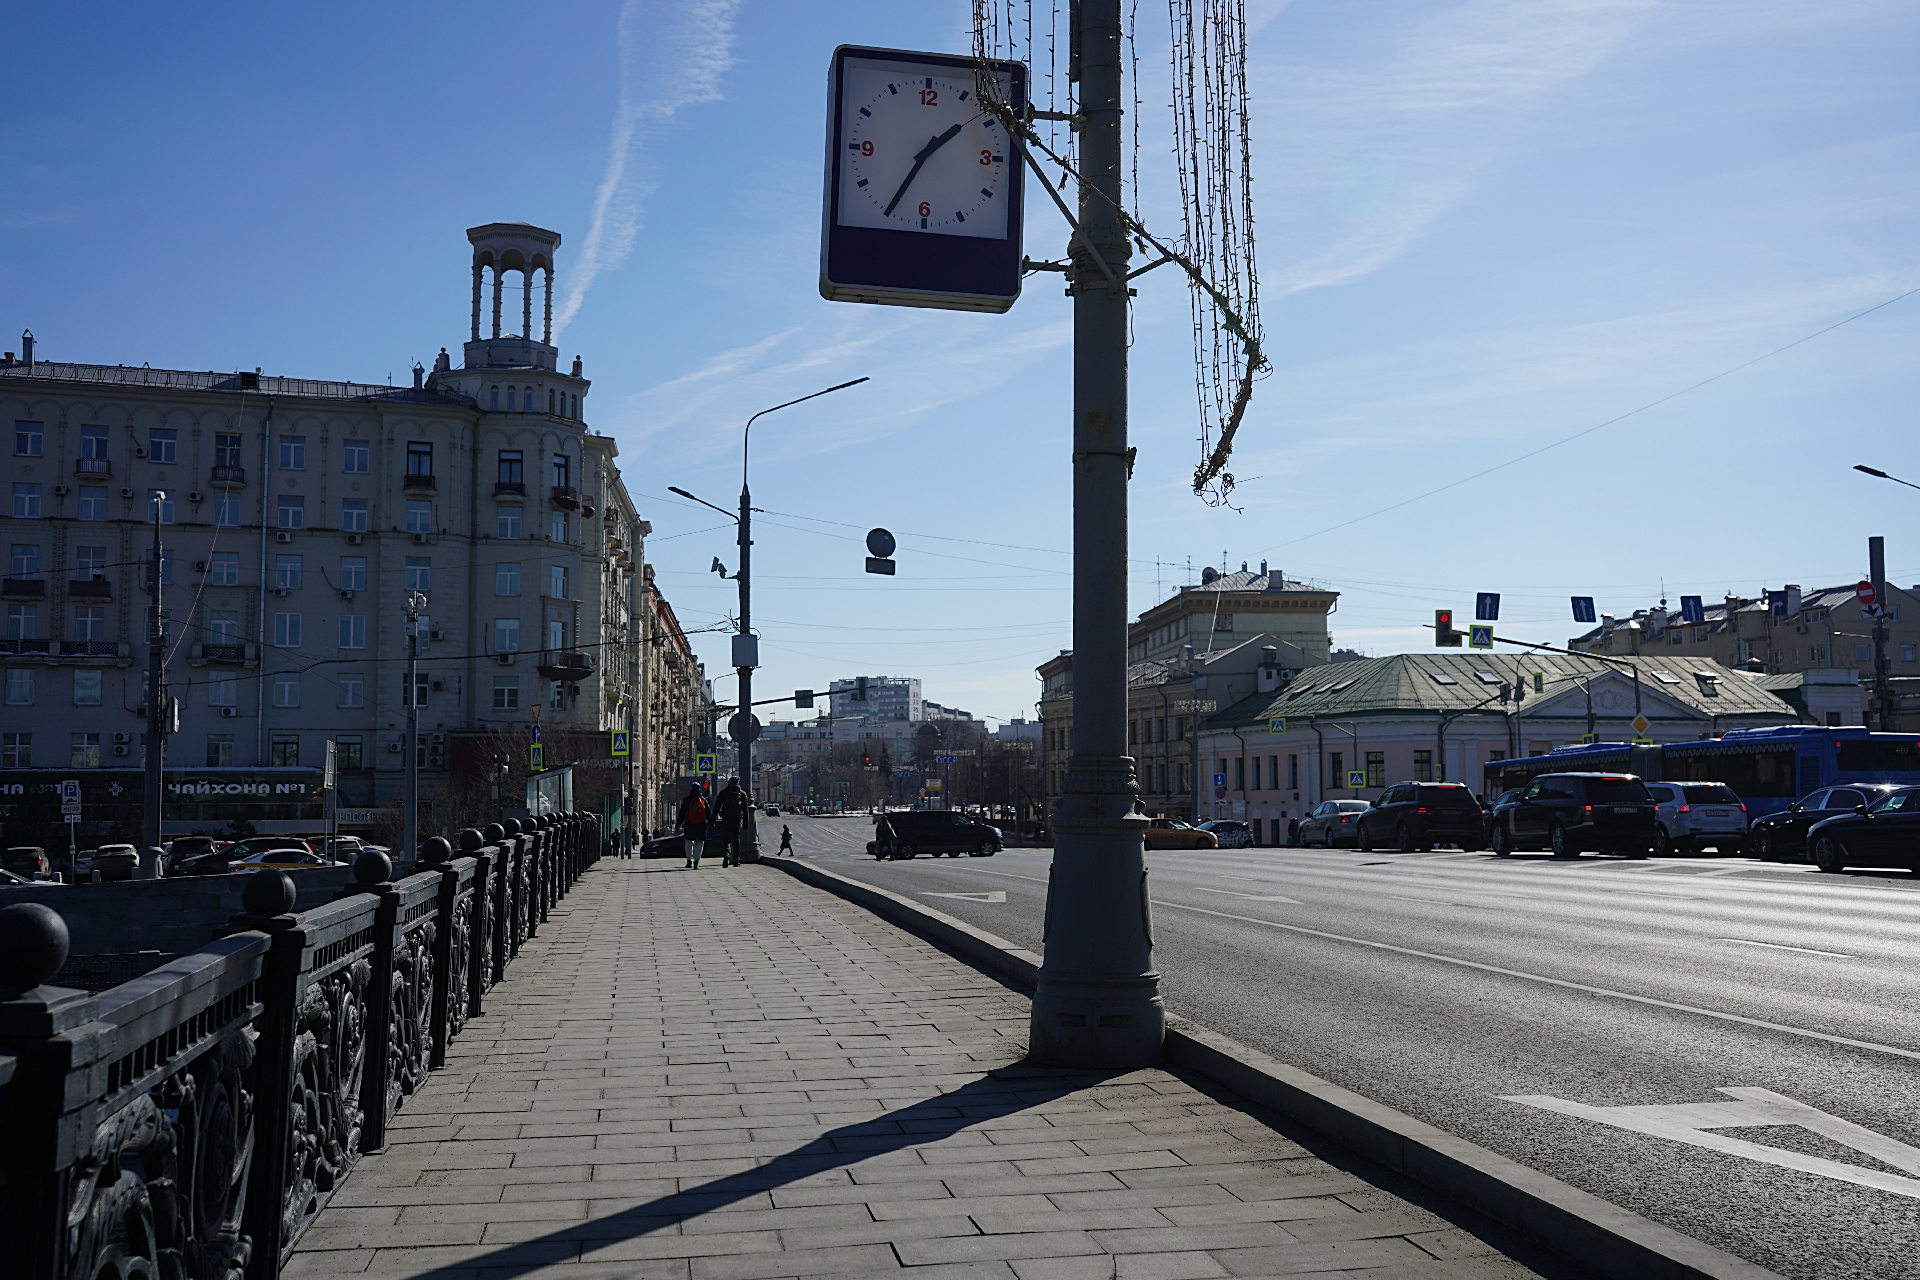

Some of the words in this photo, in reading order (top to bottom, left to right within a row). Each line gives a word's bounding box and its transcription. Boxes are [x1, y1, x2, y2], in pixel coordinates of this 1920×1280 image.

[918, 90, 938, 107] 12
[861, 140, 874, 156] 9
[979, 150, 992, 166] 3
[918, 201, 931, 217] 6
[577, 758, 622, 769] МИРАТОР
[167, 780, 270, 794] ЧАЙХОНА
[275, 783, 306, 794] №1
